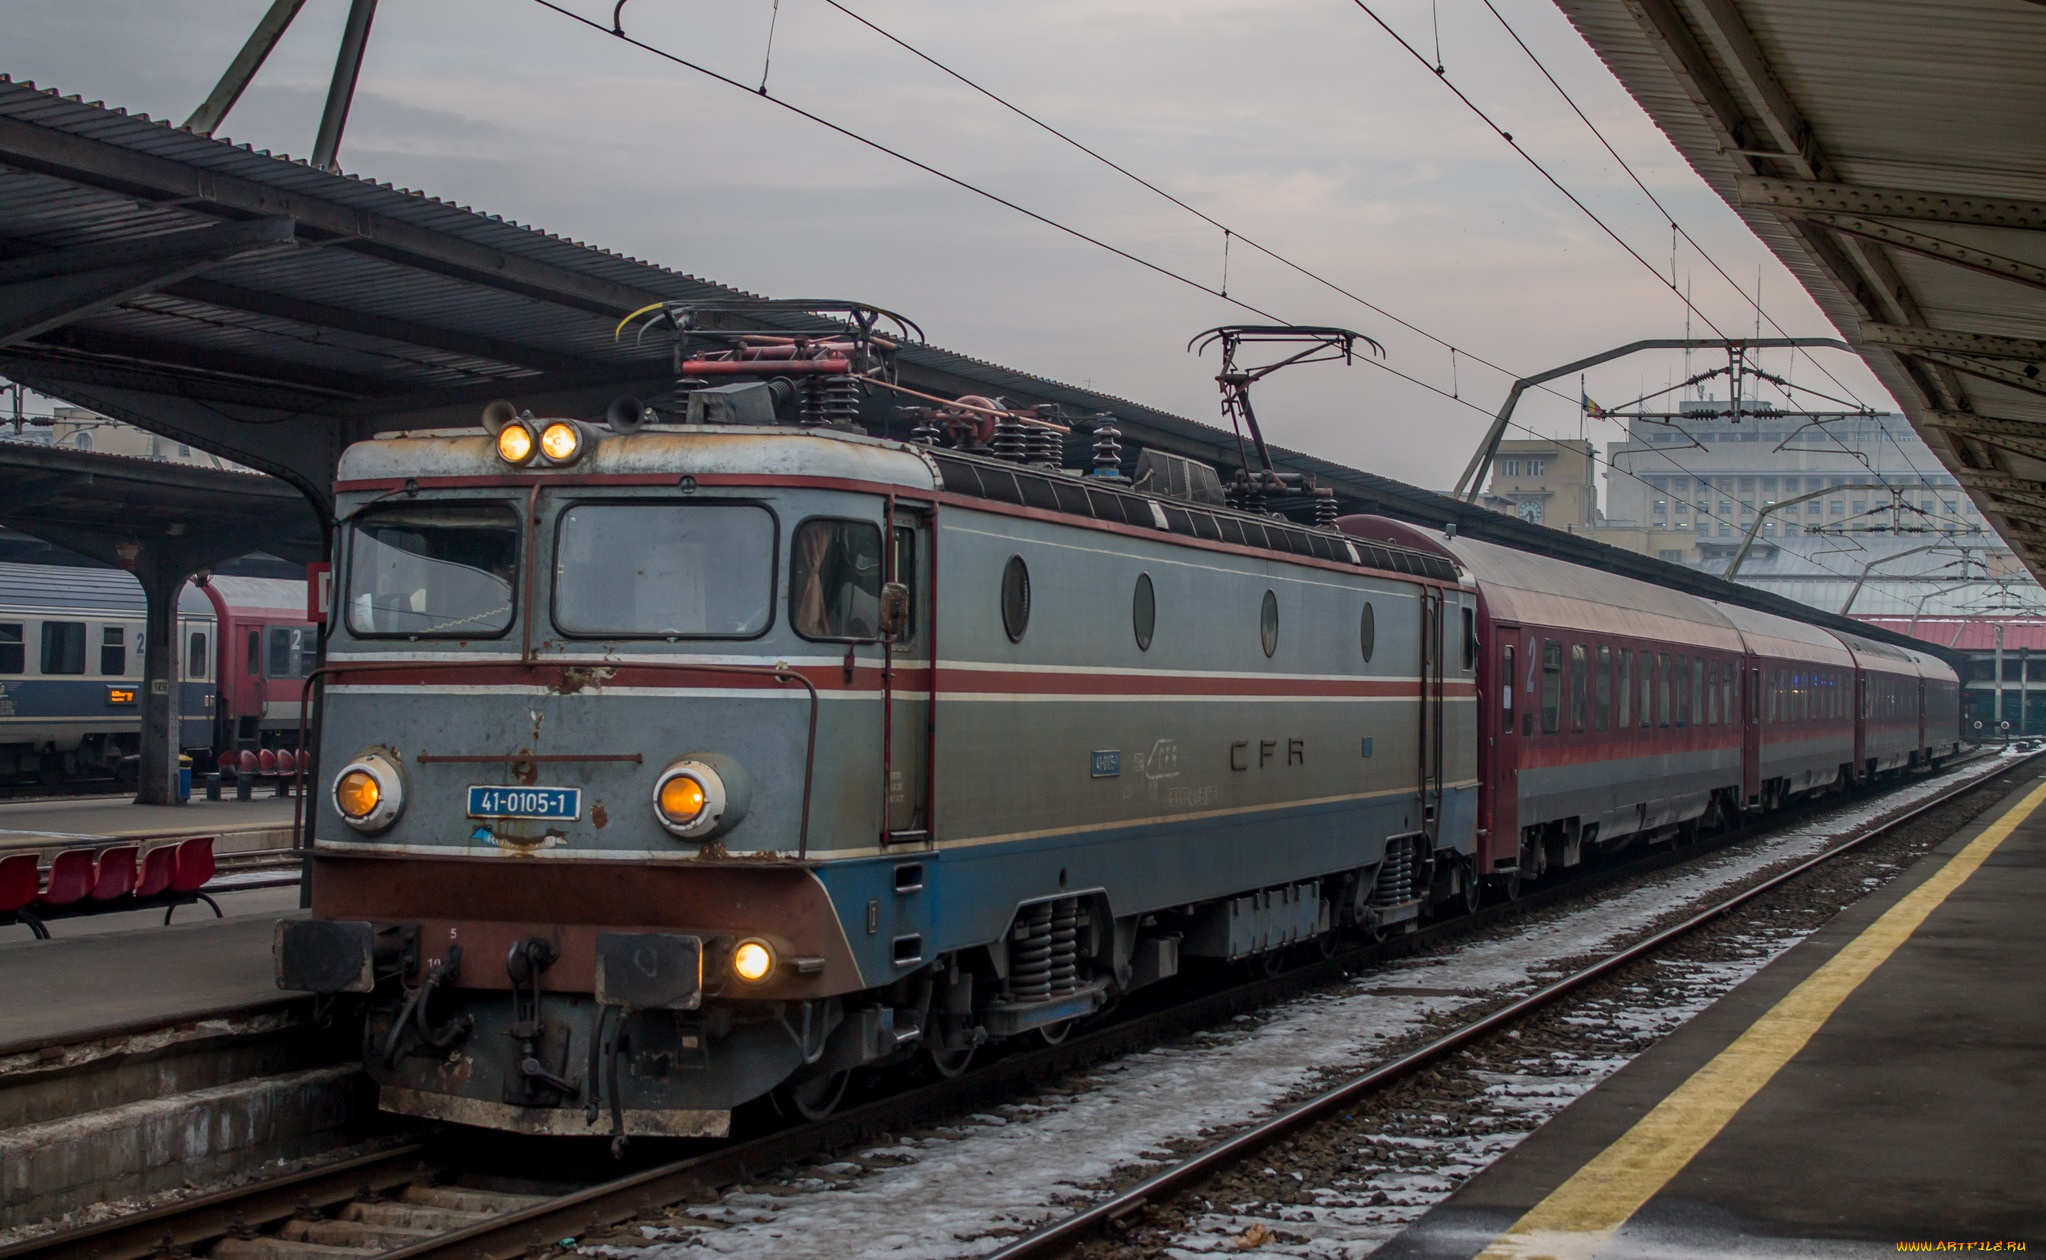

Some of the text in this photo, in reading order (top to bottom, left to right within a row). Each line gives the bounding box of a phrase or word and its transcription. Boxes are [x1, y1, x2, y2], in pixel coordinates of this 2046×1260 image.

[136, 632, 145, 654] 2
[291, 629, 302, 650] 2
[1526, 636, 1536, 693] 2
[1230, 737, 1304, 771] CFR
[481, 792, 565, 814] 41-0105-1
[450, 928, 457, 939] 5
